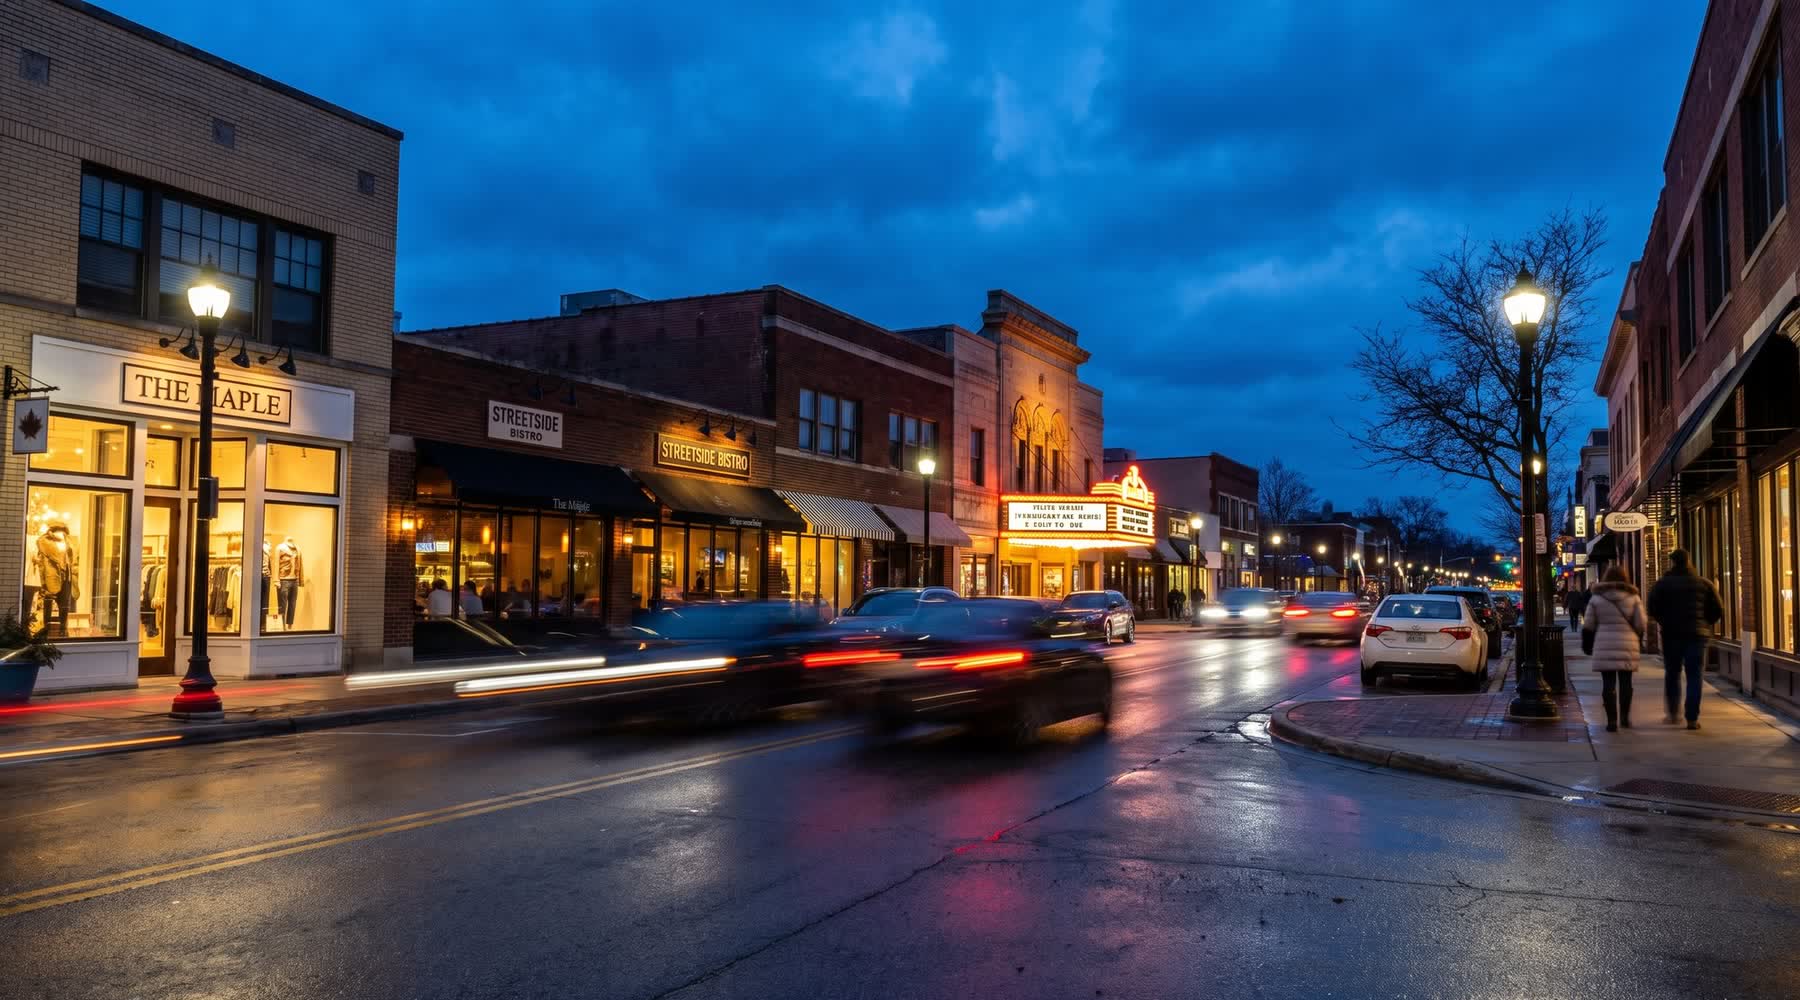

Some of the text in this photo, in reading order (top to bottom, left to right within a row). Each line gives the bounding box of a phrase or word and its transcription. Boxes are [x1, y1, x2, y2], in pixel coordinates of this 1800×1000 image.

[135, 374, 191, 403] THE
[492, 405, 559, 433] STREETSIDE
[510, 428, 543, 441] BISTRO
[661, 441, 748, 471] STREETSIDE BISTRO
